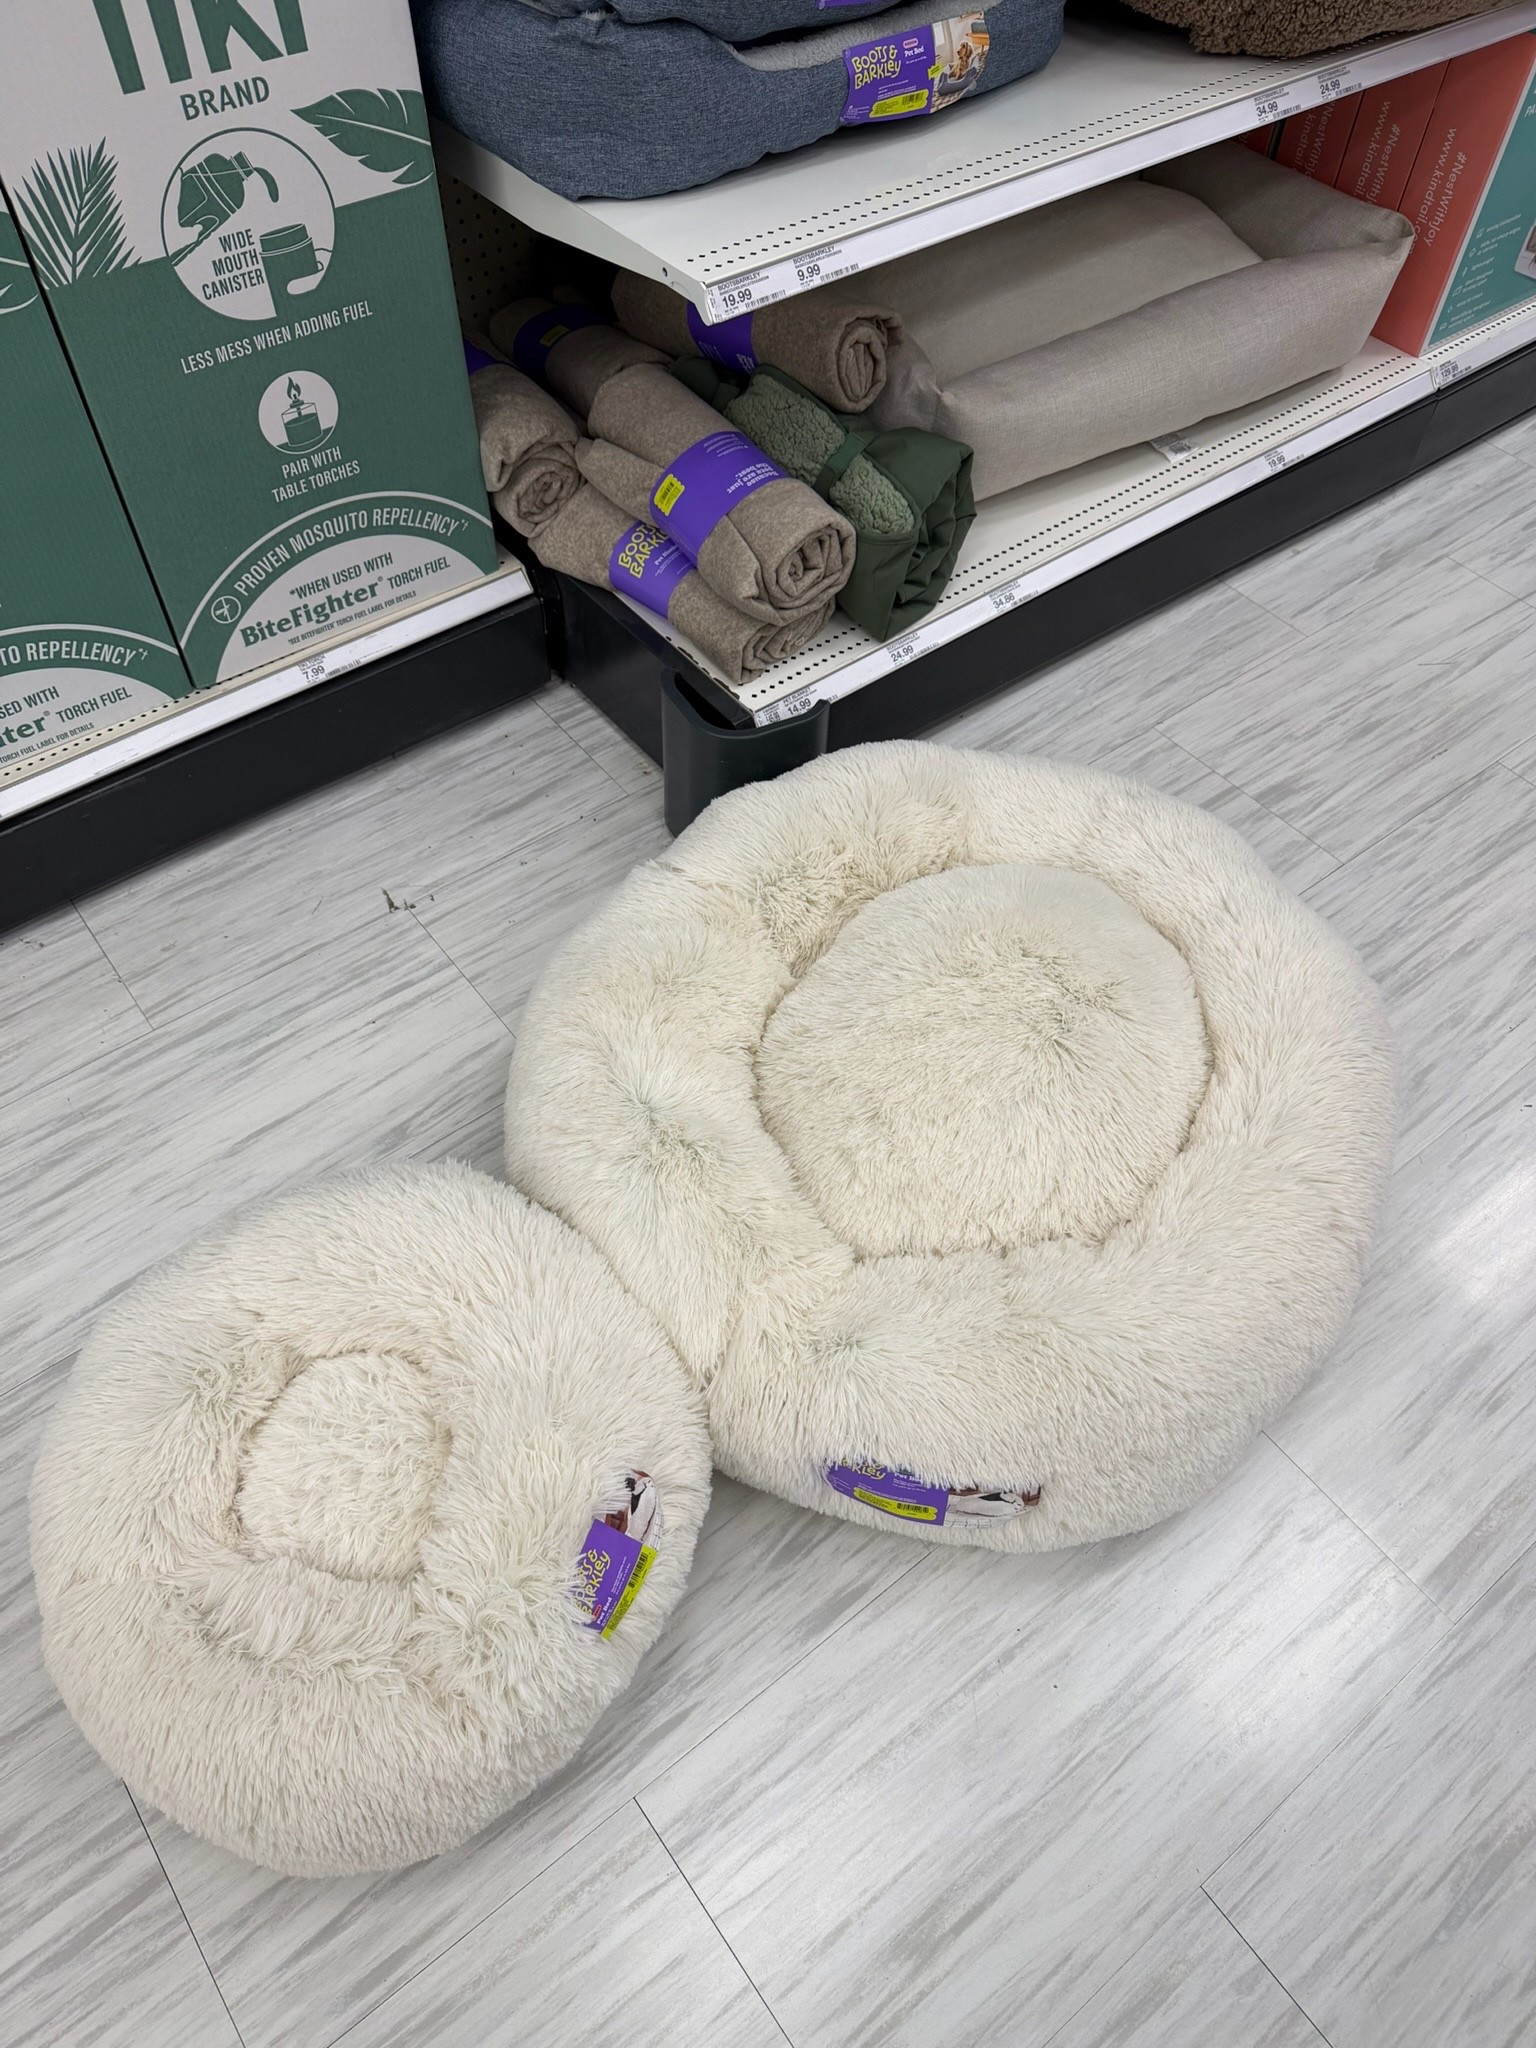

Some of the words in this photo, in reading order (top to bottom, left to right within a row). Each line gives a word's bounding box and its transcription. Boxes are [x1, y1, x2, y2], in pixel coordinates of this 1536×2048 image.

[852, 46, 888, 71] BOOTS
[889, 45, 898, 58] &
[180, 76, 270, 121] BRAND
[1320, 79, 1340, 95] 24.99
[1256, 101, 1278, 117] 34.99
[1366, 124, 1400, 201] #NestWithJ
[218, 229, 255, 253] WIDE
[212, 249, 259, 277] MOUTH
[797, 264, 821, 281] 9.99
[202, 269, 264, 300] CANISTER
[722, 288, 752, 308] 19.99
[180, 350, 214, 374] LESS
[215, 338, 252, 364] MESS
[253, 325, 292, 351] WHEN
[294, 310, 341, 338] ADDING
[342, 300, 373, 323] FUEL
[281, 455, 309, 479] PAIR
[311, 446, 342, 470] WITH
[1268, 455, 1285, 468] 19.99
[272, 479, 308, 503] TABLE
[308, 460, 361, 491] TORCHES
[233, 545, 291, 597] PROVEN
[289, 510, 368, 555] MOSQUITO
[332, 564, 363, 586] USED
[364, 552, 393, 574] WITH
[387, 570, 423, 594] TORCH
[424, 556, 451, 577] FUEL
[368, 604, 385, 614] LABEL
[395, 590, 417, 603] DETAILS
[891, 645, 914, 662] 24.99
[302, 665, 325, 680] 7.99
[23, 686, 60, 708] WITH
[56, 697, 100, 723] TORCH
[100, 686, 132, 708] FUEL
[788, 698, 811, 715] 14.99
[20, 745, 37, 756] FUEL
[36, 737, 57, 750] LABEL
[56, 732, 69, 742] FOR
[69, 722, 95, 737] DETAILS
